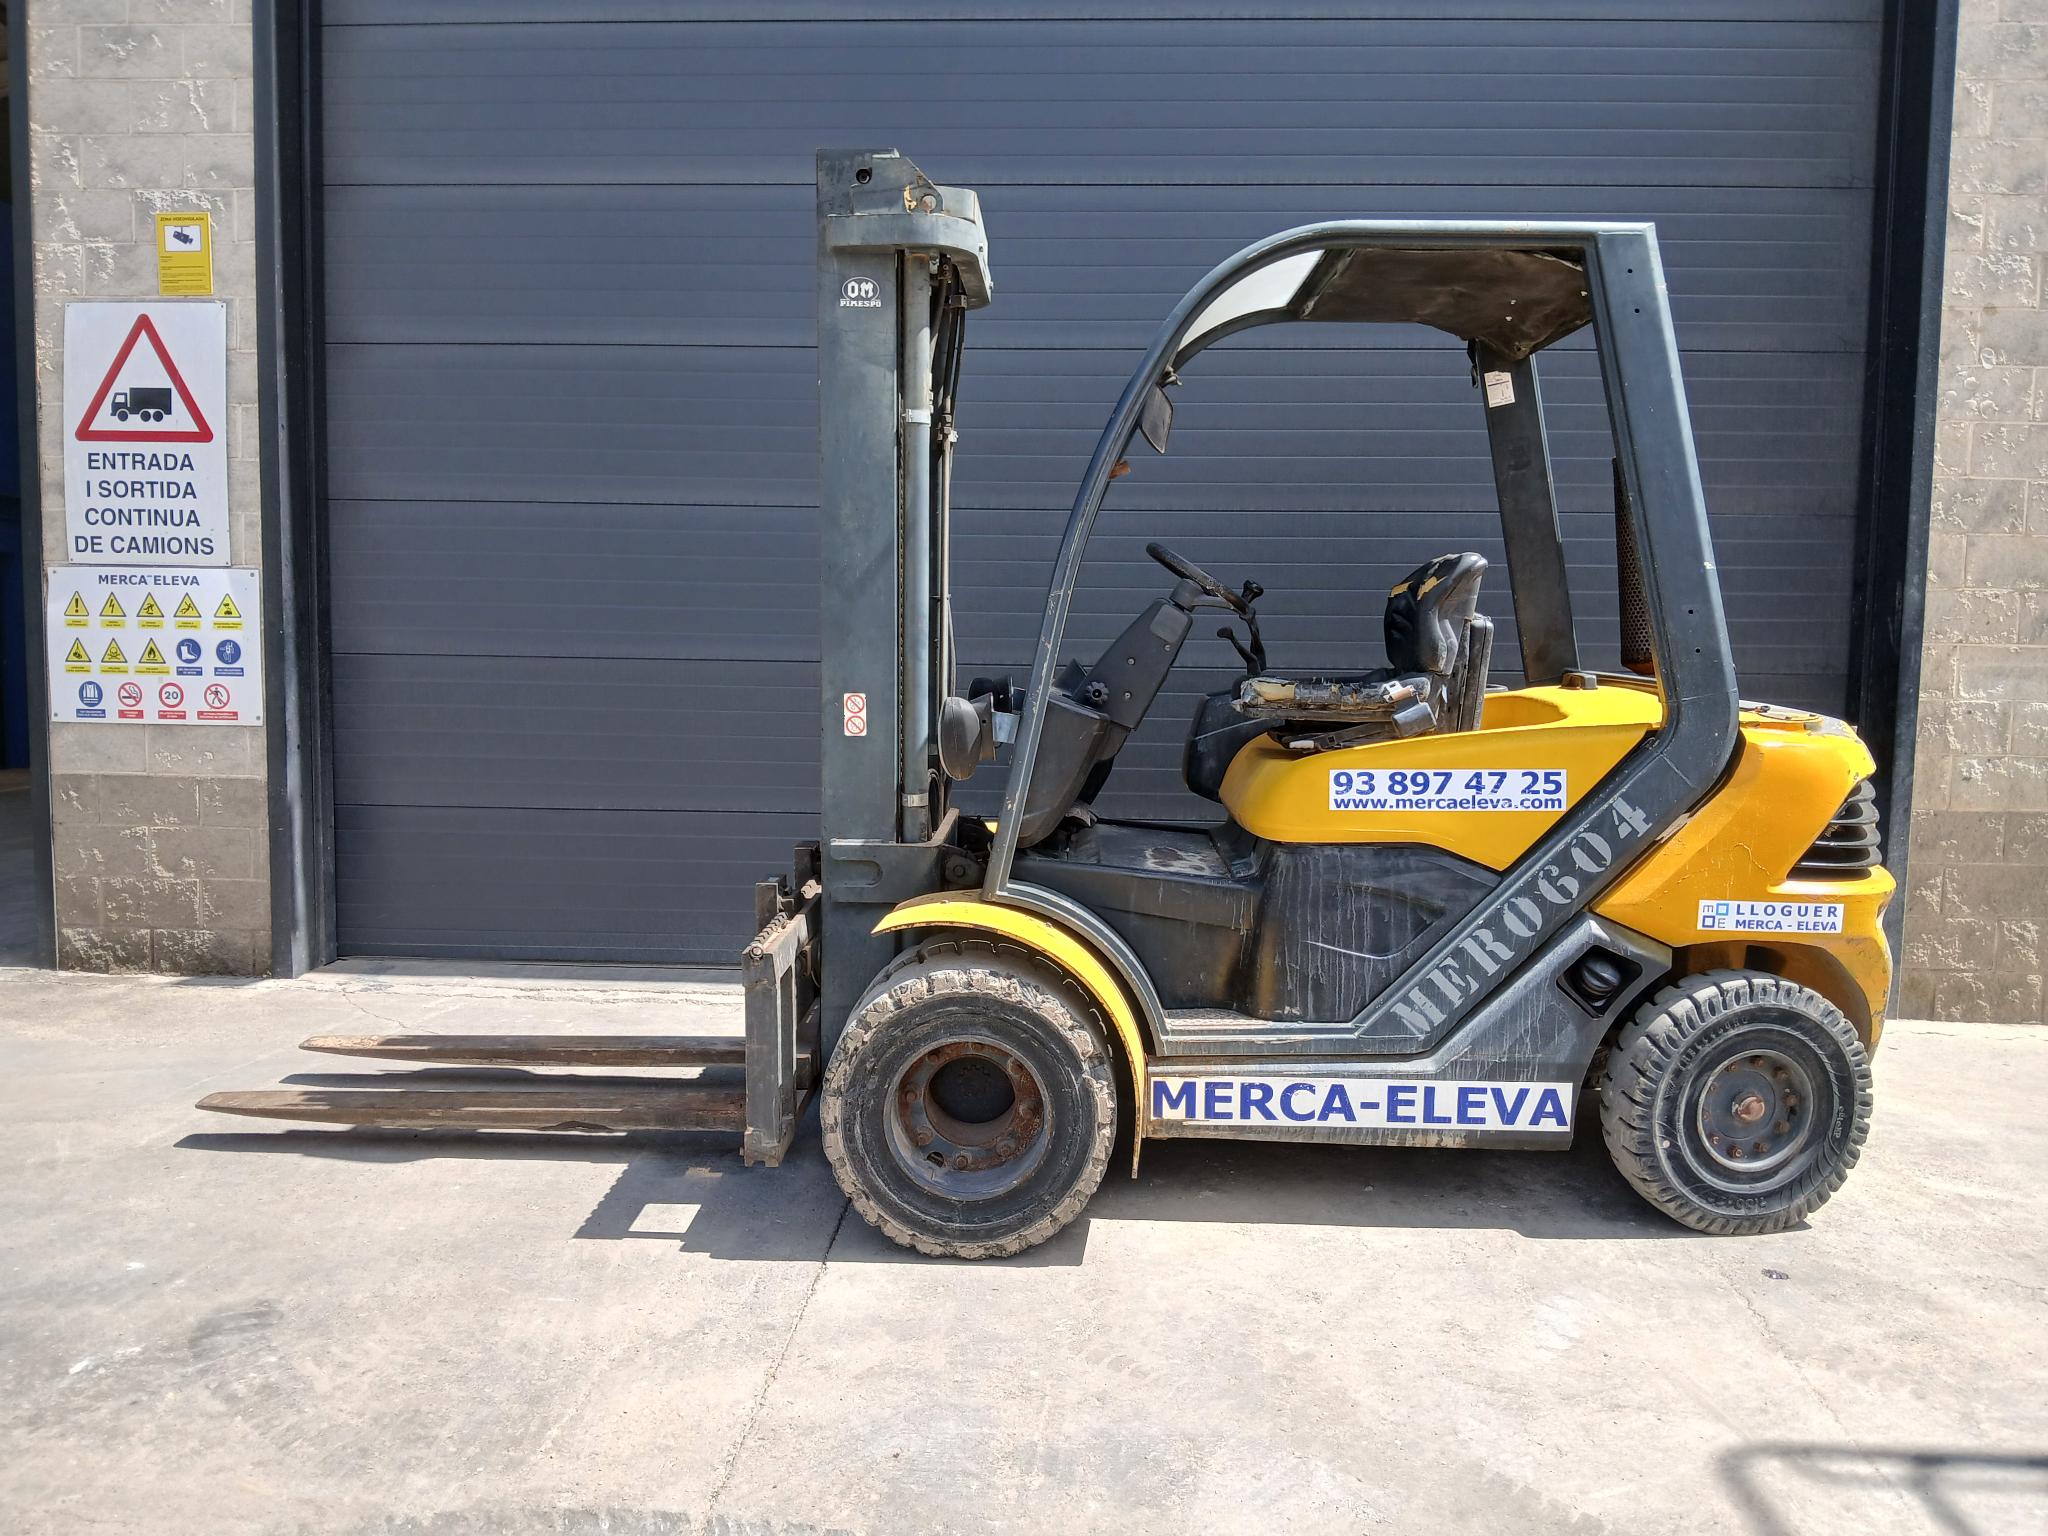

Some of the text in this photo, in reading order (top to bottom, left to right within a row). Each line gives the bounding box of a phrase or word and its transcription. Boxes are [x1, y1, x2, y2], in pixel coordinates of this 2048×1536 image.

[847, 281, 874, 298] OM
[87, 452, 195, 471] ENTRADA
[86, 480, 197, 499] I SORTIDA
[85, 507, 201, 527] CONTINUA
[75, 535, 214, 555] DE CAMIONS
[164, 691, 179, 700] 20
[1333, 771, 1562, 795] 93 897 47 25
[1333, 795, 1562, 810] www.mercaeleva.com
[1736, 903, 1838, 918] LLOGUER
[1735, 919, 1783, 930] MERCA
[1796, 920, 1837, 931] ELEVA
[1152, 1080, 1569, 1127] MERCA-ELEVA
